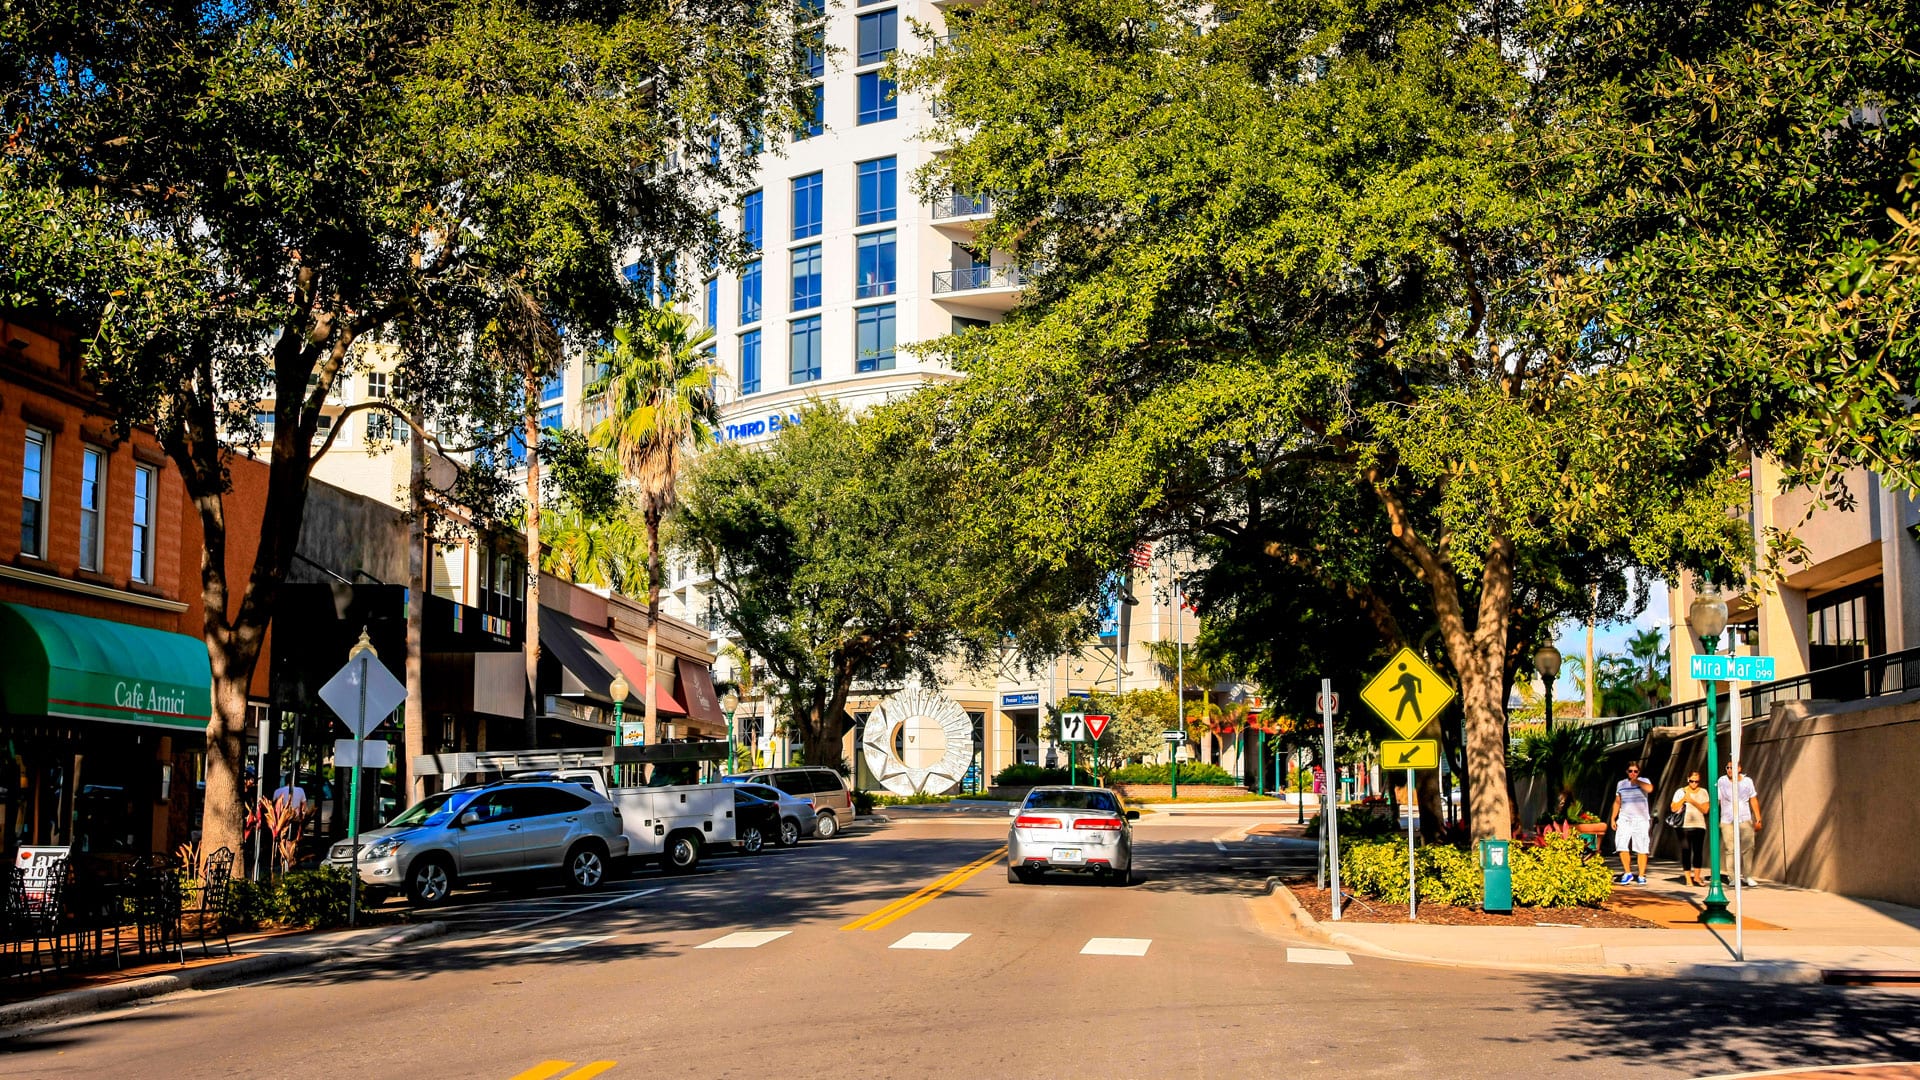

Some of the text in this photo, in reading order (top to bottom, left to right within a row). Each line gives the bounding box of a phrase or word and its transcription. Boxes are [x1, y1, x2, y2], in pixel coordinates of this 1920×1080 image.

[726, 420, 766, 441] THIRD
[1693, 658, 1765, 677] Mira Mar CT
[1755, 670, 1772, 679] 099
[114, 681, 185, 715] Cafe Amici
